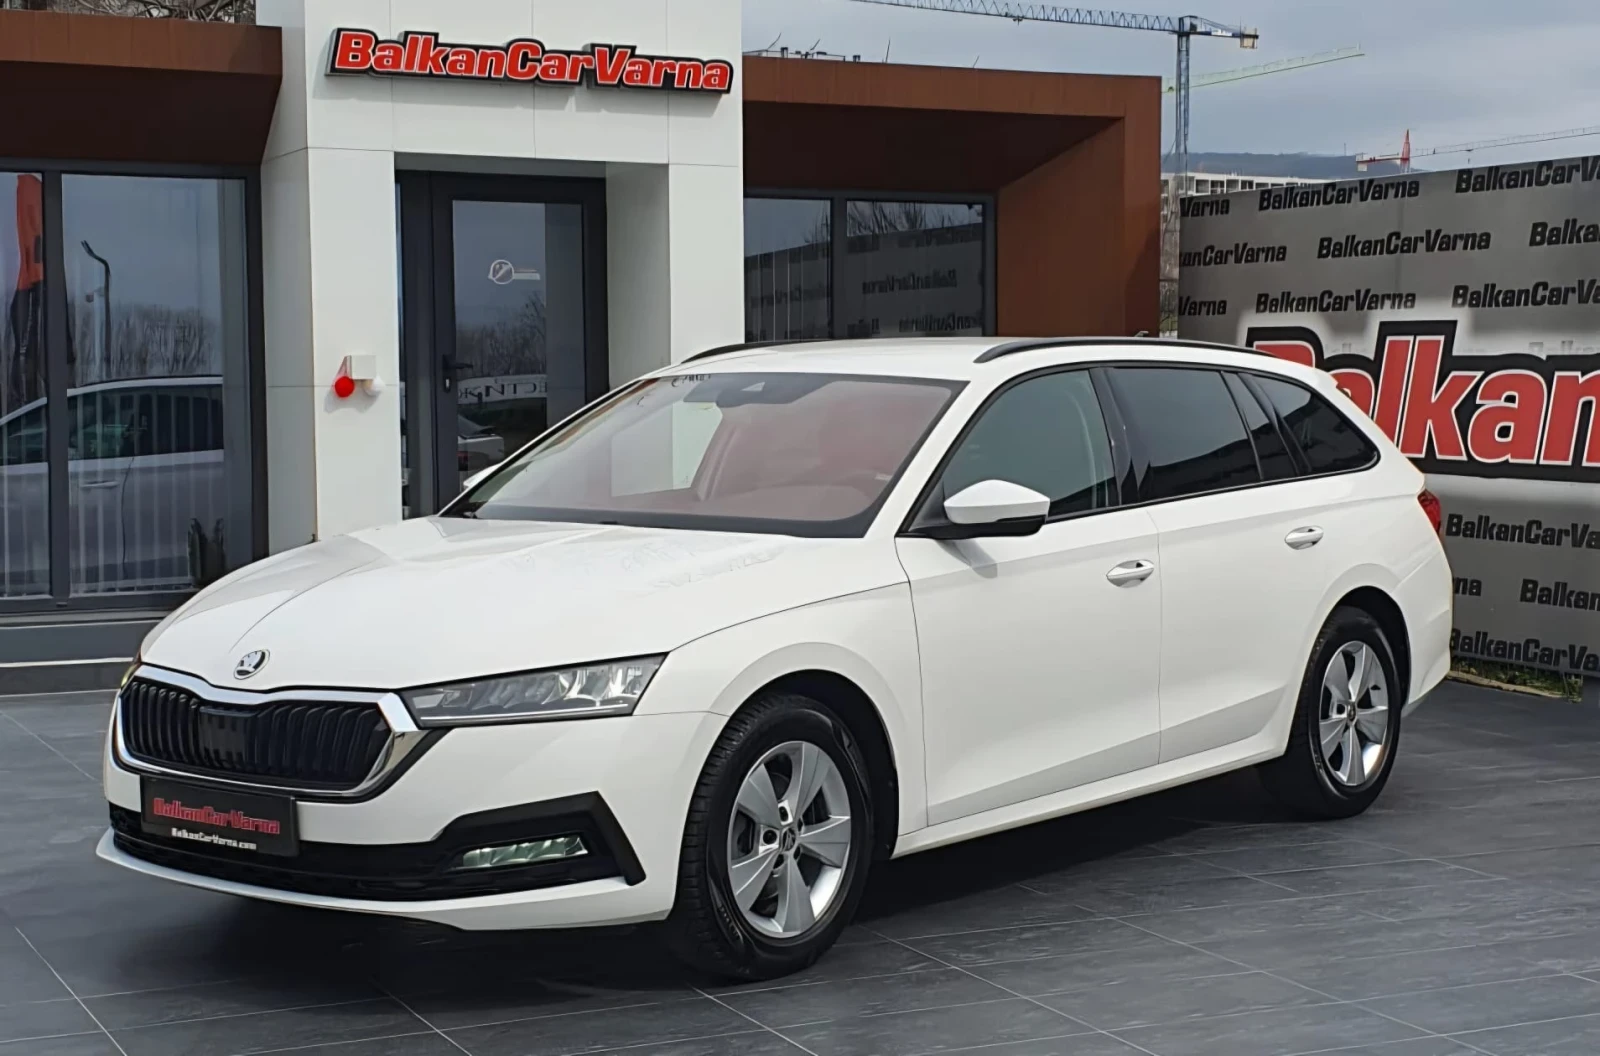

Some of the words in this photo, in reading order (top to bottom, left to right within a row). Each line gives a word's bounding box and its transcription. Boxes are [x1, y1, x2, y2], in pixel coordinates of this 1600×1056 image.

[335, 31, 731, 90] BalkanCarVarna
[1258, 178, 1420, 211] BalkanCarVarna
[1455, 156, 1600, 194] BalkanCarV
[1179, 242, 1288, 267] anCarVarna
[1317, 229, 1491, 259] BalkanCarVarna
[1529, 218, 1600, 247] Balka
[1178, 296, 1227, 316] Varna
[1256, 288, 1417, 313] BalkanCarVarna
[1453, 577, 1482, 596] na
